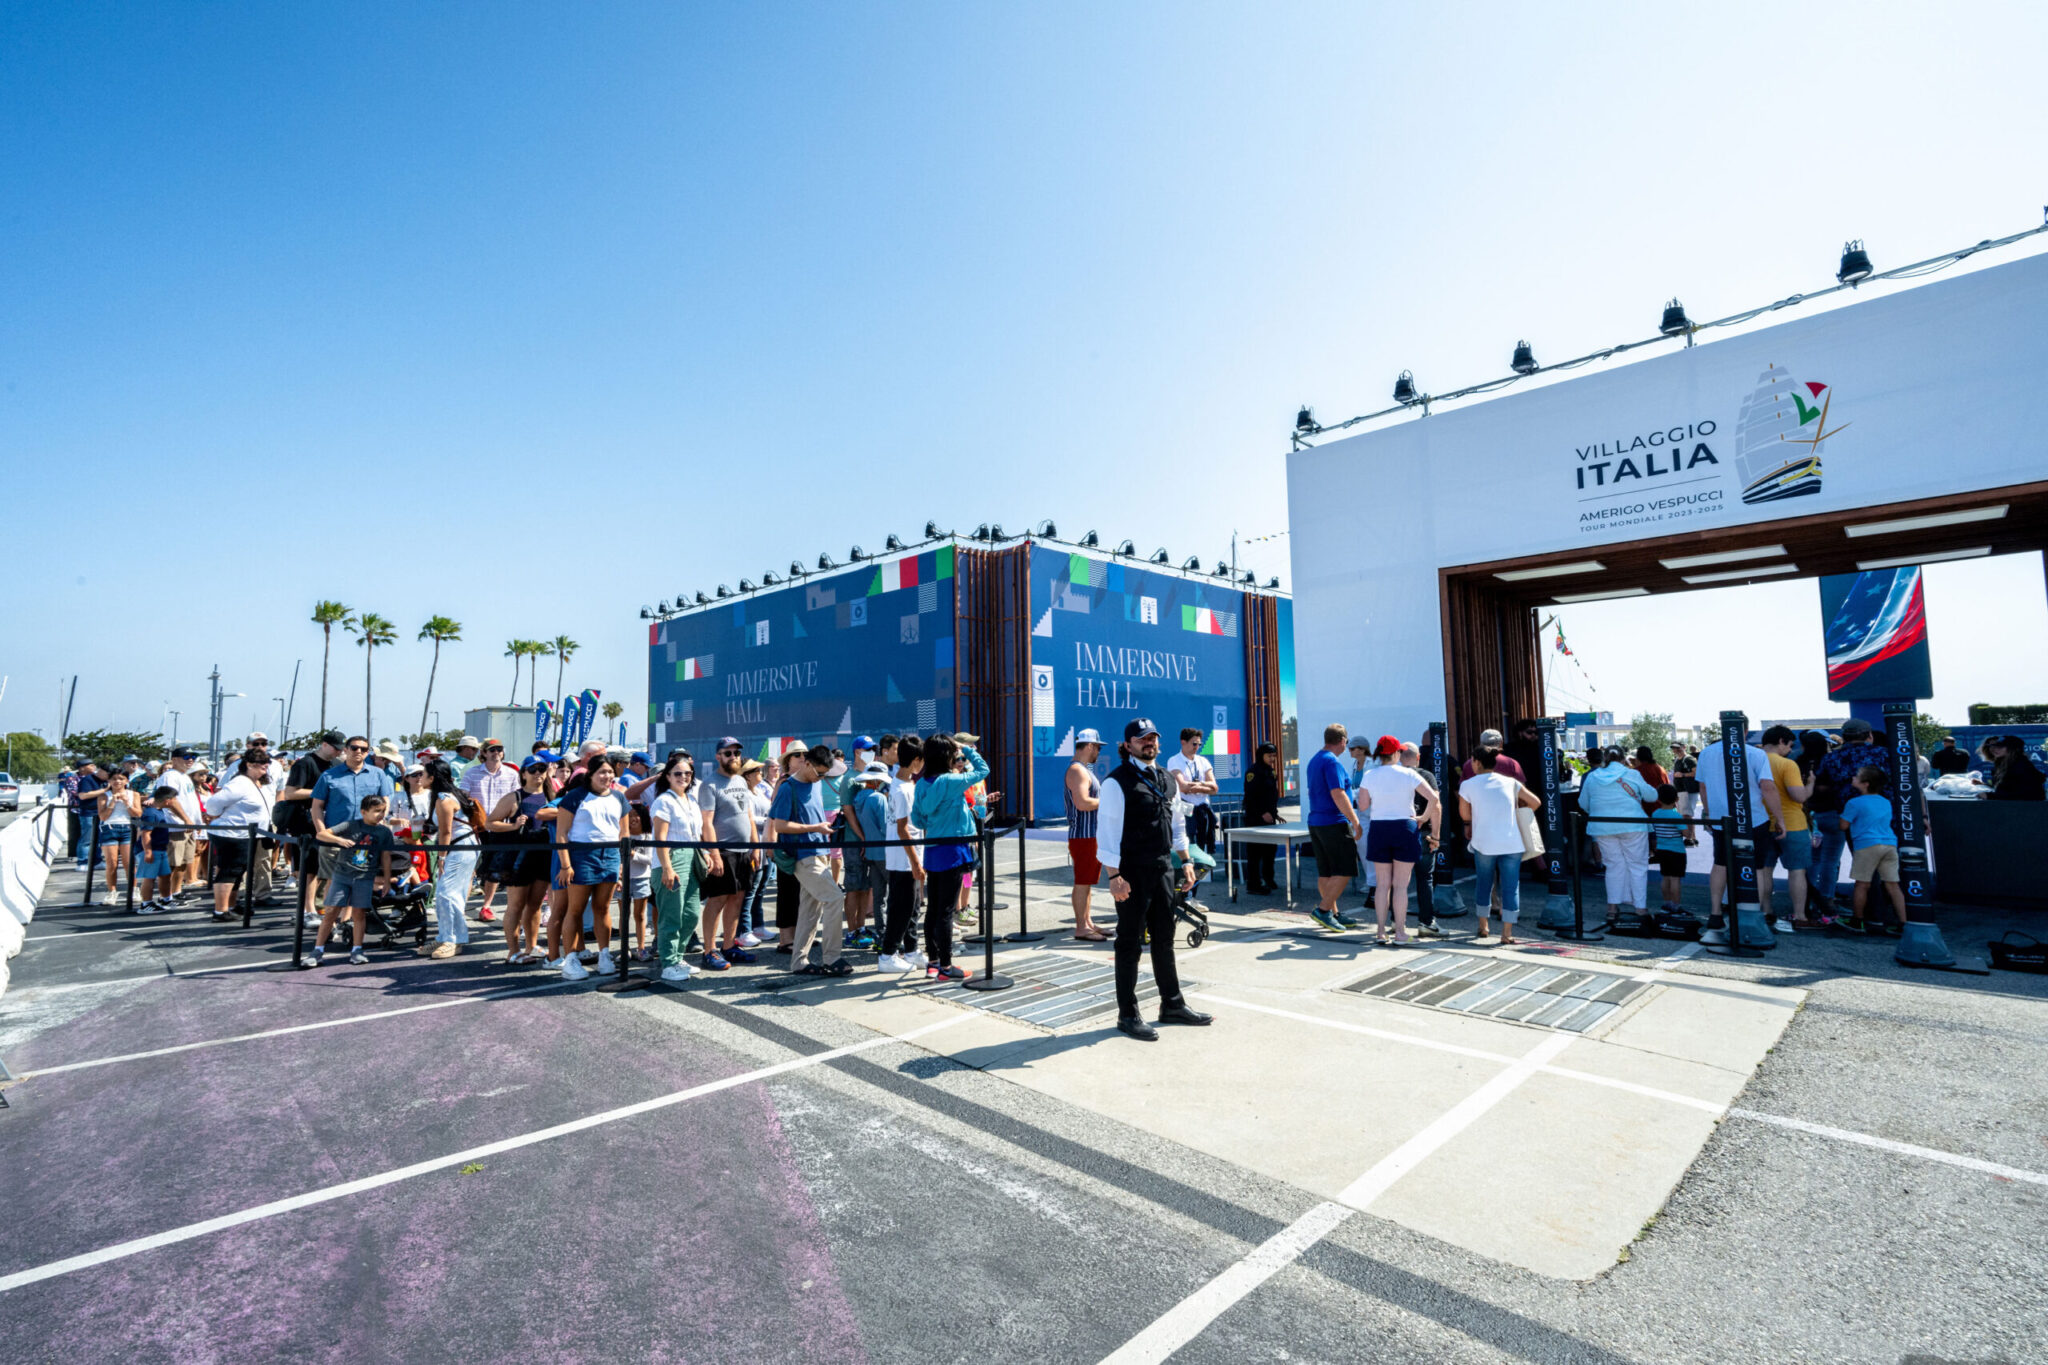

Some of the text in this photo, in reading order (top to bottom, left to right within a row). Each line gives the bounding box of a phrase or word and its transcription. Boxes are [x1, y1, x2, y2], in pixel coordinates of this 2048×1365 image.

[1575, 420, 1717, 461] VILLAGGIO
[1576, 442, 1719, 490] ITALIA
[1579, 489, 1724, 522] AMERIGO VESPUCCI
[1579, 503, 1724, 533] TOUR MONDIALE 2023-2025
[726, 660, 818, 697] IMMERSIVE
[1075, 641, 1197, 682] IMMERSIVE
[726, 698, 767, 724] HALL
[1076, 677, 1138, 709] HALL
[1547, 793, 1556, 831] VENUE
[1734, 793, 1747, 834] VENUE
[1900, 796, 1914, 841] VENUE
